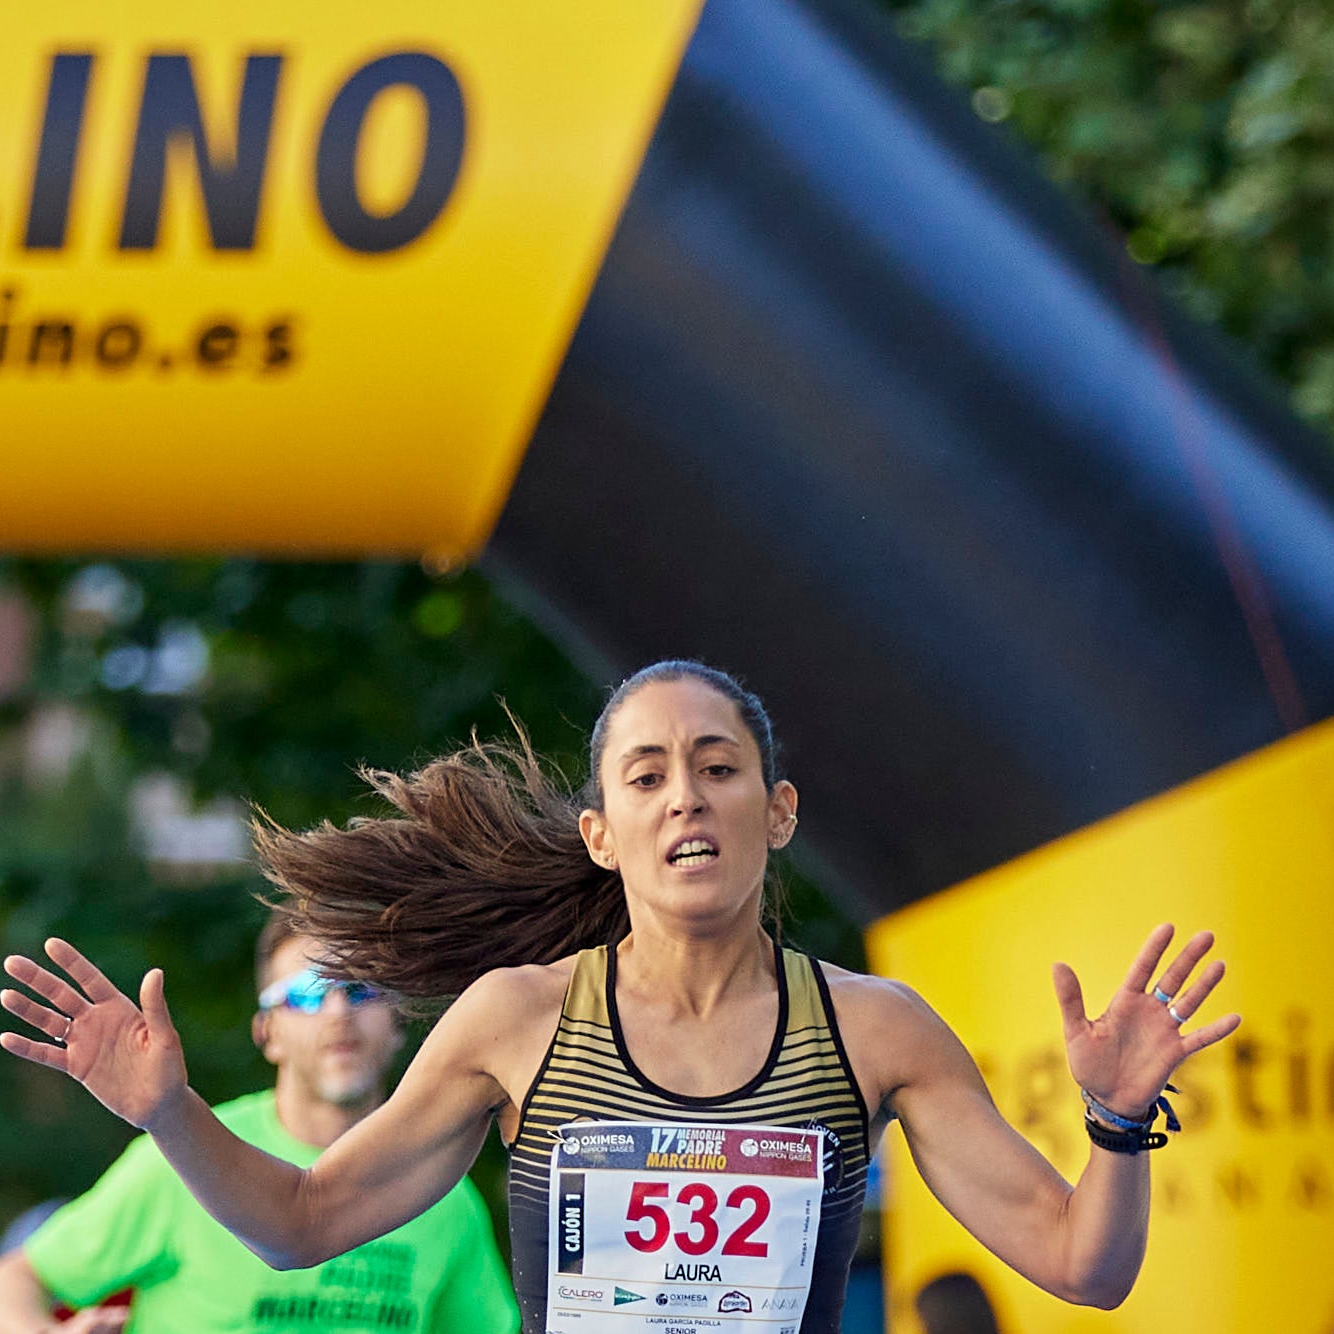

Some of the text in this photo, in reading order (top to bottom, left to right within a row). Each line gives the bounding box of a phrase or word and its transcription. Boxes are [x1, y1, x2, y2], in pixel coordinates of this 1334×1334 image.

[580, 1134, 635, 1146] OXIMESA
[650, 1128, 678, 1154] 17
[677, 1128, 726, 1142] MEMORIAL
[677, 1140, 723, 1155] PADRE
[759, 1139, 812, 1154] OXIMESA
[645, 1153, 727, 1171] MARCELINO
[562, 1193, 582, 1252] CAJÓN 1
[623, 1180, 772, 1259] 532
[664, 1263, 722, 1282] LAURA
[561, 1287, 604, 1300] CALERO
[669, 1293, 708, 1303] OXIMESA
[645, 1317, 668, 1325] LAURA
[694, 1319, 722, 1327] PADILLA
